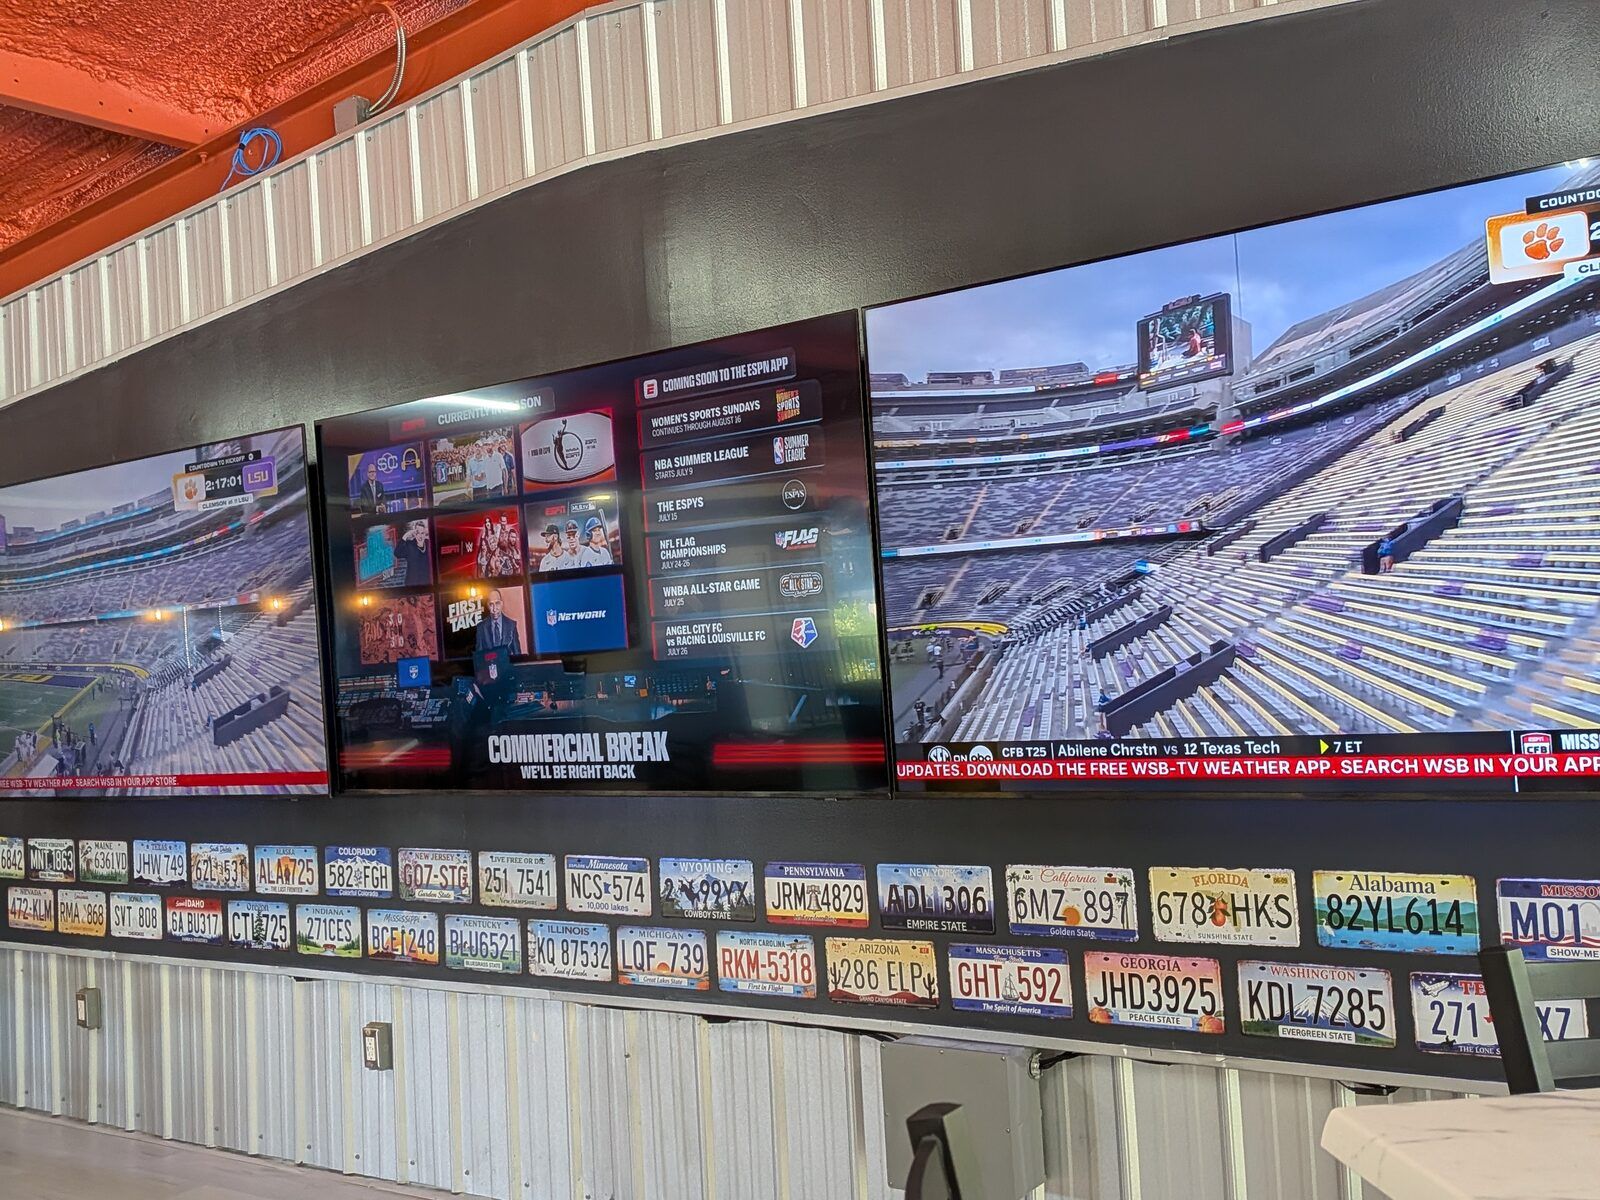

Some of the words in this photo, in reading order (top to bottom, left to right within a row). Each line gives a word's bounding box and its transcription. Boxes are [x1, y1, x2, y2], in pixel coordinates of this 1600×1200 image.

[662, 375, 694, 393] COMING
[695, 371, 718, 387] SOON
[719, 369, 729, 382] TO
[730, 364, 746, 380] THE
[747, 360, 769, 376] ESPN
[770, 356, 788, 372] APP
[651, 412, 688, 428] WOMEN'S
[690, 407, 721, 422] SPORTS
[723, 400, 760, 417] SUNDAYS
[655, 459, 672, 470] NBA
[674, 453, 711, 468] SUMMER
[714, 446, 749, 461] LEAGUE
[248, 470, 269, 484] LSU
[655, 469, 675, 480] STARTS
[205, 475, 242, 490] 2:17:01
[202, 501, 227, 510] CLEMSON
[657, 501, 674, 513] THE
[676, 496, 704, 511] ESPYS
[658, 513, 670, 522] JULY
[660, 538, 674, 549] NFL
[676, 537, 695, 547] FLAG
[661, 544, 726, 560] CHAMPIONSHIPS
[661, 561, 673, 569] JULY
[675, 560, 690, 568] 24-26
[663, 585, 688, 597] WNBA
[734, 579, 760, 590] GAME
[664, 599, 676, 607] JULY
[666, 625, 691, 636] ANGEL
[693, 624, 710, 634] CITY
[712, 623, 722, 632] FC
[676, 635, 706, 646] RACING
[755, 630, 766, 641] FC
[667, 648, 680, 656] JULY
[488, 733, 603, 764] COMMERCIAL
[606, 731, 670, 762] BREAK
[1003, 746, 1024, 758] CFB
[1027, 746, 1046, 757] T25
[1058, 744, 1106, 757] Abilene
[1110, 743, 1157, 756] Chrstn
[1164, 746, 1178, 755] vs
[1184, 744, 1197, 755] 12
[1200, 742, 1241, 755] Texas
[1246, 740, 1280, 754] Tech
[1334, 742, 1342, 753] 7
[1345, 741, 1363, 753] ET
[1527, 745, 1548, 754] CFB
[520, 765, 551, 779] WE'LL
[553, 765, 567, 779] BE
[569, 765, 601, 779] RIGHT
[603, 764, 636, 779] BACK
[897, 763, 963, 777] UPDATES.
[967, 763, 1052, 777] DOWNLOAD
[1057, 762, 1087, 776] THE
[1090, 762, 1127, 776] FREE
[1132, 761, 1199, 775] WSB-TV
[1203, 760, 1290, 775] WEATHER
[1295, 760, 1336, 774] APP.
[1341, 759, 1419, 774] SEARCH
[1423, 759, 1469, 773] WSB
[1474, 759, 1494, 773] IN
[1499, 758, 1558, 773] YOUR
[33, 779, 61, 788] WEATHER
[76, 778, 100, 787] SEARCH
[123, 777, 141, 786] YOUR
[94, 842, 113, 850] MAINE
[338, 847, 377, 856] COLORADO
[415, 852, 430, 860] NEW
[431, 853, 454, 861] JERSEY
[491, 856, 506, 864] LIVE
[586, 859, 629, 871] Minnesota
[680, 862, 732, 873] WYOMING
[784, 866, 845, 877] PENNSYLVANIA
[329, 864, 353, 887] 582
[364, 865, 388, 889] FGH
[909, 868, 929, 877] NEW
[931, 868, 955, 877] YORK
[1040, 869, 1097, 887] California
[485, 867, 508, 893] 251
[517, 868, 550, 896] 7541
[1192, 873, 1249, 888] FLORIDA
[1349, 874, 1436, 894] Alabama
[339, 889, 357, 897] Colorful
[571, 873, 603, 900] NCS
[613, 875, 645, 903] 574
[772, 881, 806, 910] JRM
[821, 883, 863, 913] 4829
[887, 885, 934, 913] ADL
[943, 886, 987, 915] 306
[187, 900, 204, 908] IDAHO
[246, 903, 269, 911] Oregon
[587, 902, 610, 911] 10,000
[611, 903, 629, 912] lakes
[1014, 887, 1067, 922] 6MZ
[1083, 890, 1129, 925] 897
[1157, 891, 1207, 926] 678
[1231, 893, 1292, 928] HKS
[115, 905, 132, 927] SVT
[139, 907, 157, 928] 808
[684, 910, 711, 919] COWBOY
[712, 911, 731, 919] STATE
[1326, 894, 1464, 937] 82YL614
[307, 917, 352, 942] 271CES
[463, 920, 502, 928] KENTUCKY
[906, 919, 938, 930] EMPIRE
[941, 921, 967, 932] STATE
[547, 926, 590, 936] ILLINOIS
[638, 931, 684, 940] MICHIGAN
[1050, 927, 1075, 937] Golden
[1077, 929, 1096, 938] State
[450, 929, 516, 961] BLU6521
[739, 938, 758, 946] NORTH
[758, 939, 786, 947] CAROLINA
[537, 937, 556, 966] KQ
[561, 939, 609, 970] 87532
[858, 944, 900, 955] ARIZONA
[976, 947, 1042, 957] MASSACHUSETTS
[1551, 949, 1599, 958] SHOW-ME
[622, 940, 657, 972] LQF
[667, 942, 703, 975] 739
[721, 948, 812, 985] RKM-5318
[1120, 957, 1181, 972] GEORGIA
[840, 958, 879, 990] 286
[1270, 966, 1356, 981] WASHINGTON
[768, 983, 784, 993] Flight
[958, 961, 1002, 999] GHT
[1018, 966, 1063, 1004] 592
[1094, 970, 1216, 1016] JHD3925
[993, 1004, 1010, 1013] Spirit
[1011, 1005, 1017, 1013] of
[1017, 1006, 1041, 1015] America
[1129, 1014, 1156, 1023] PEACH
[1157, 1015, 1181, 1025] STATE
[1430, 1000, 1478, 1038] 271
[1281, 1028, 1327, 1038] EVERGREEN
[1328, 1031, 1352, 1041] STATE
